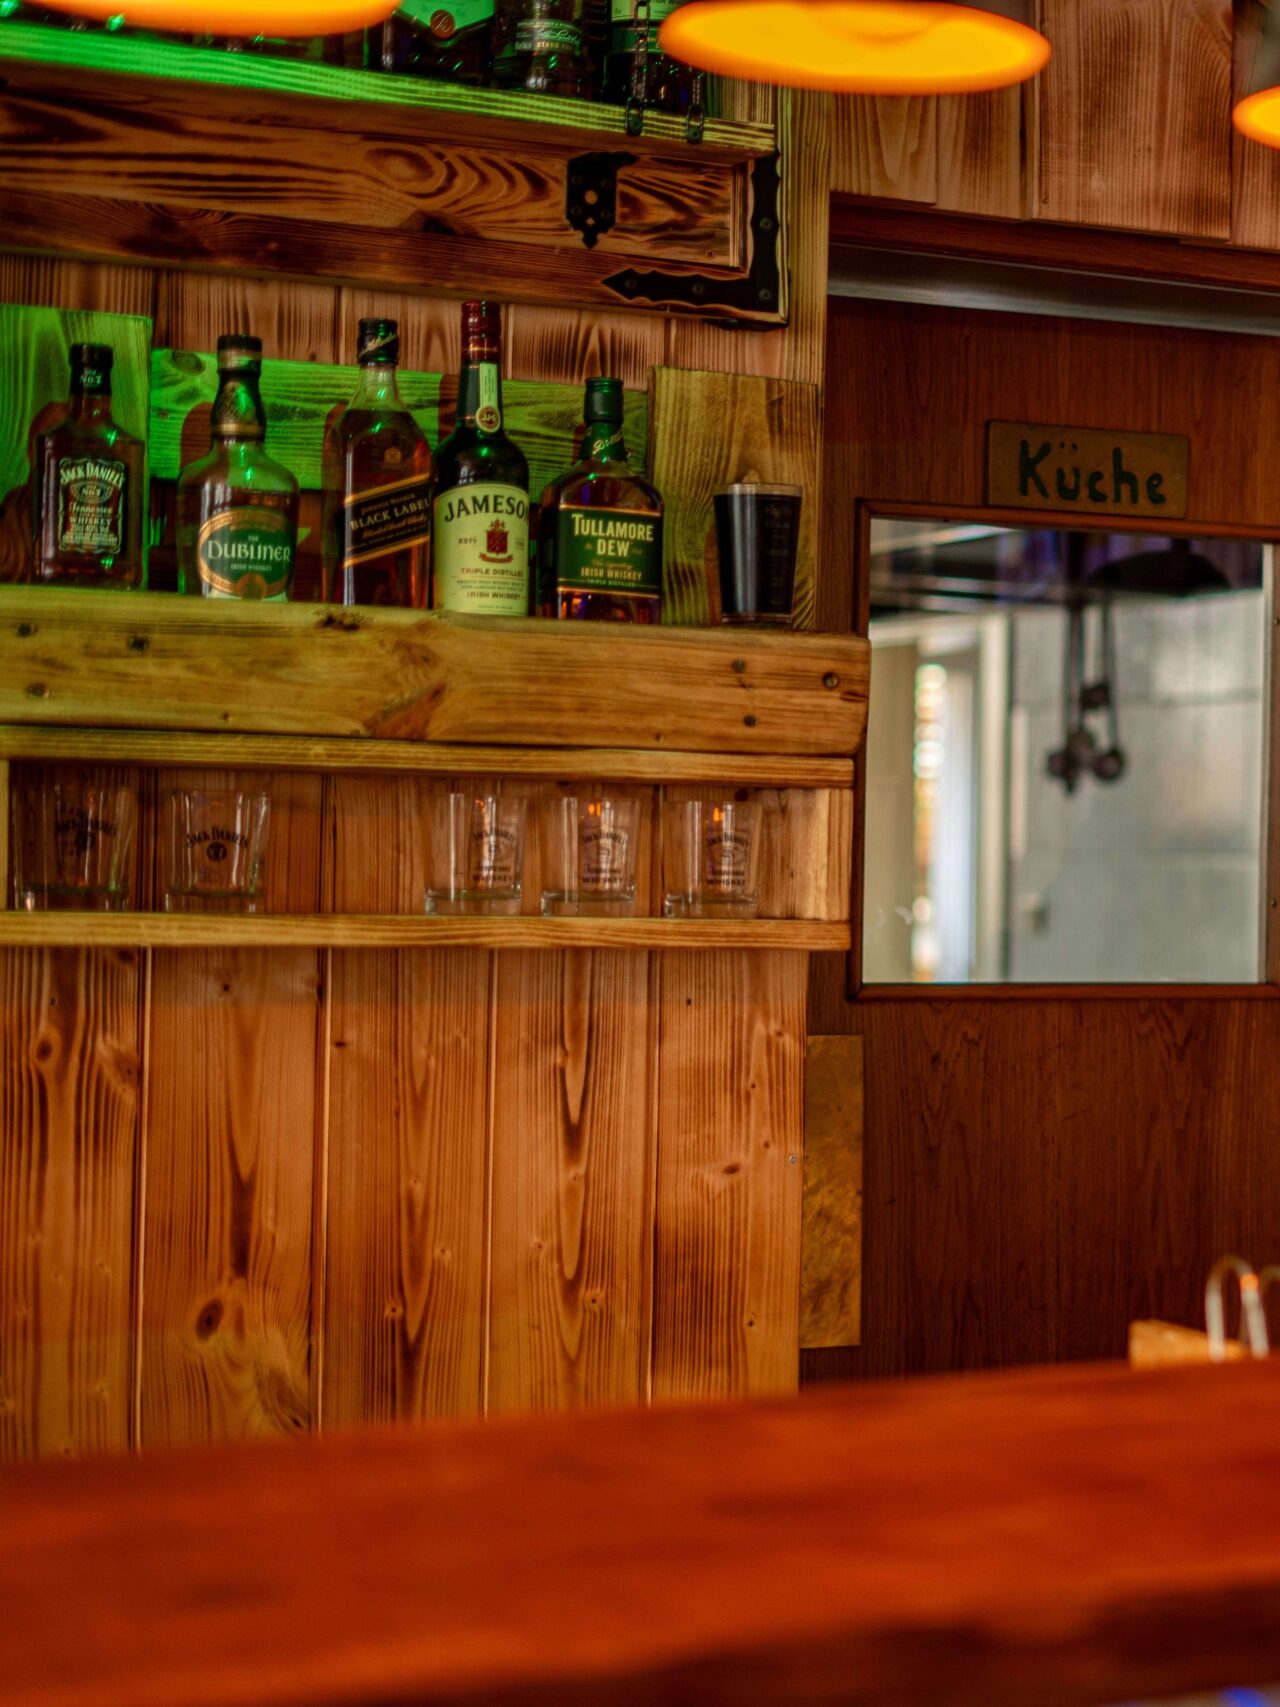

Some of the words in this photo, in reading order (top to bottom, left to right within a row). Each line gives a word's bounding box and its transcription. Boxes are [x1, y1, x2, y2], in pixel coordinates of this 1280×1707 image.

[1018, 439, 1167, 505] Küche
[350, 510, 391, 531] BLACK
[393, 498, 430, 518] LABEL
[571, 513, 654, 541] TULLAMORE
[597, 539, 630, 557] DEW
[461, 567, 490, 575] TRIPLE
[581, 567, 604, 577] IRISH
[607, 569, 642, 581] WHISKEY
